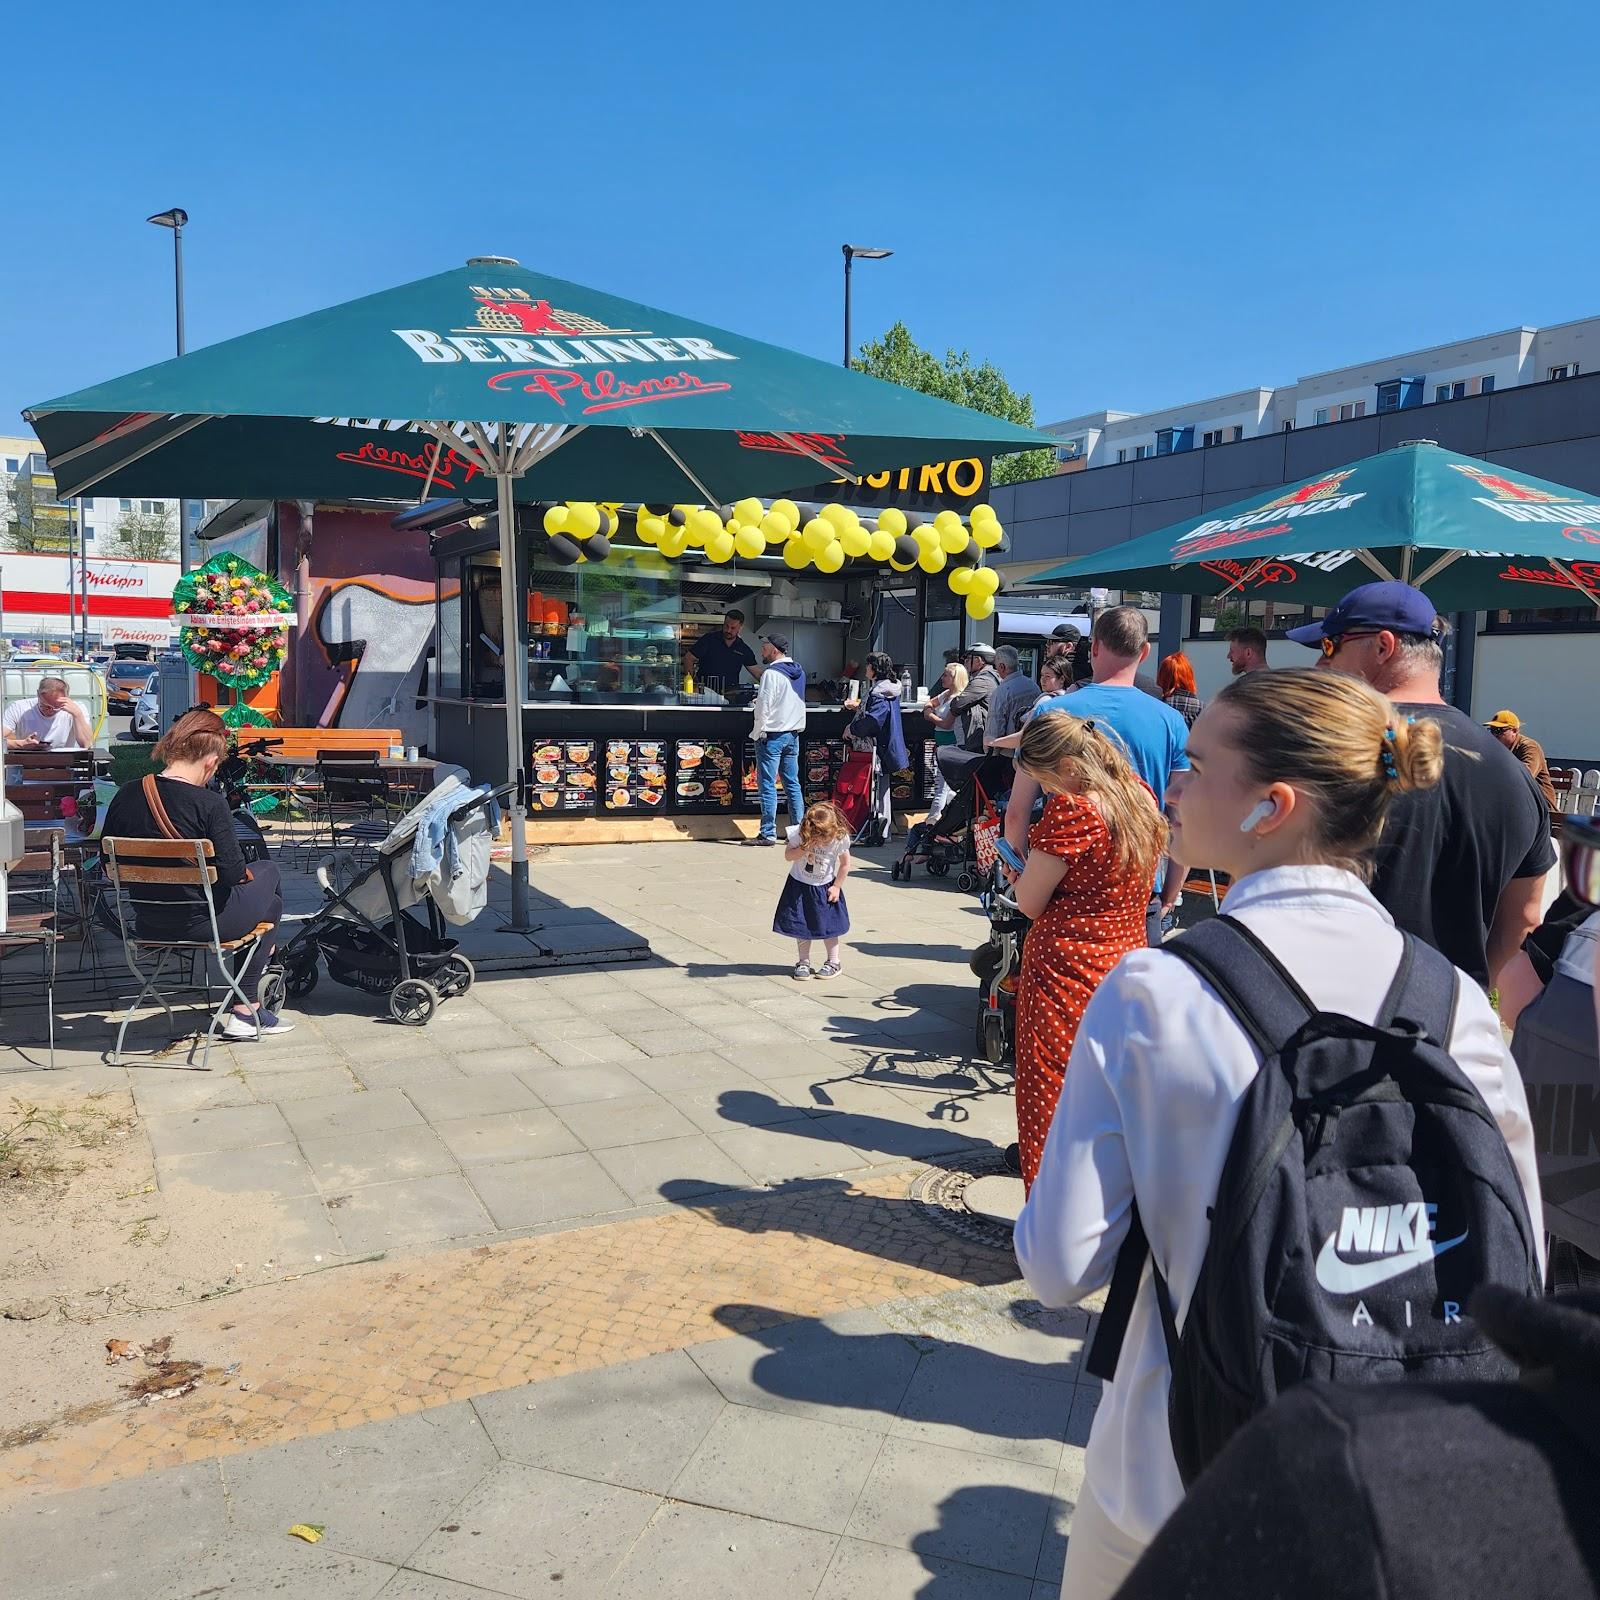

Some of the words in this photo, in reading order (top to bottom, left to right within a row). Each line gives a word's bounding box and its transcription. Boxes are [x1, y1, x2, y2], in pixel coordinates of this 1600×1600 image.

[392, 329, 741, 367] BERLINER
[487, 368, 732, 415] Pilsner
[77, 570, 143, 588] Philipps
[111, 627, 167, 641] Philipps
[359, 970, 398, 988] hauck
[1336, 1202, 1438, 1253] NIKE
